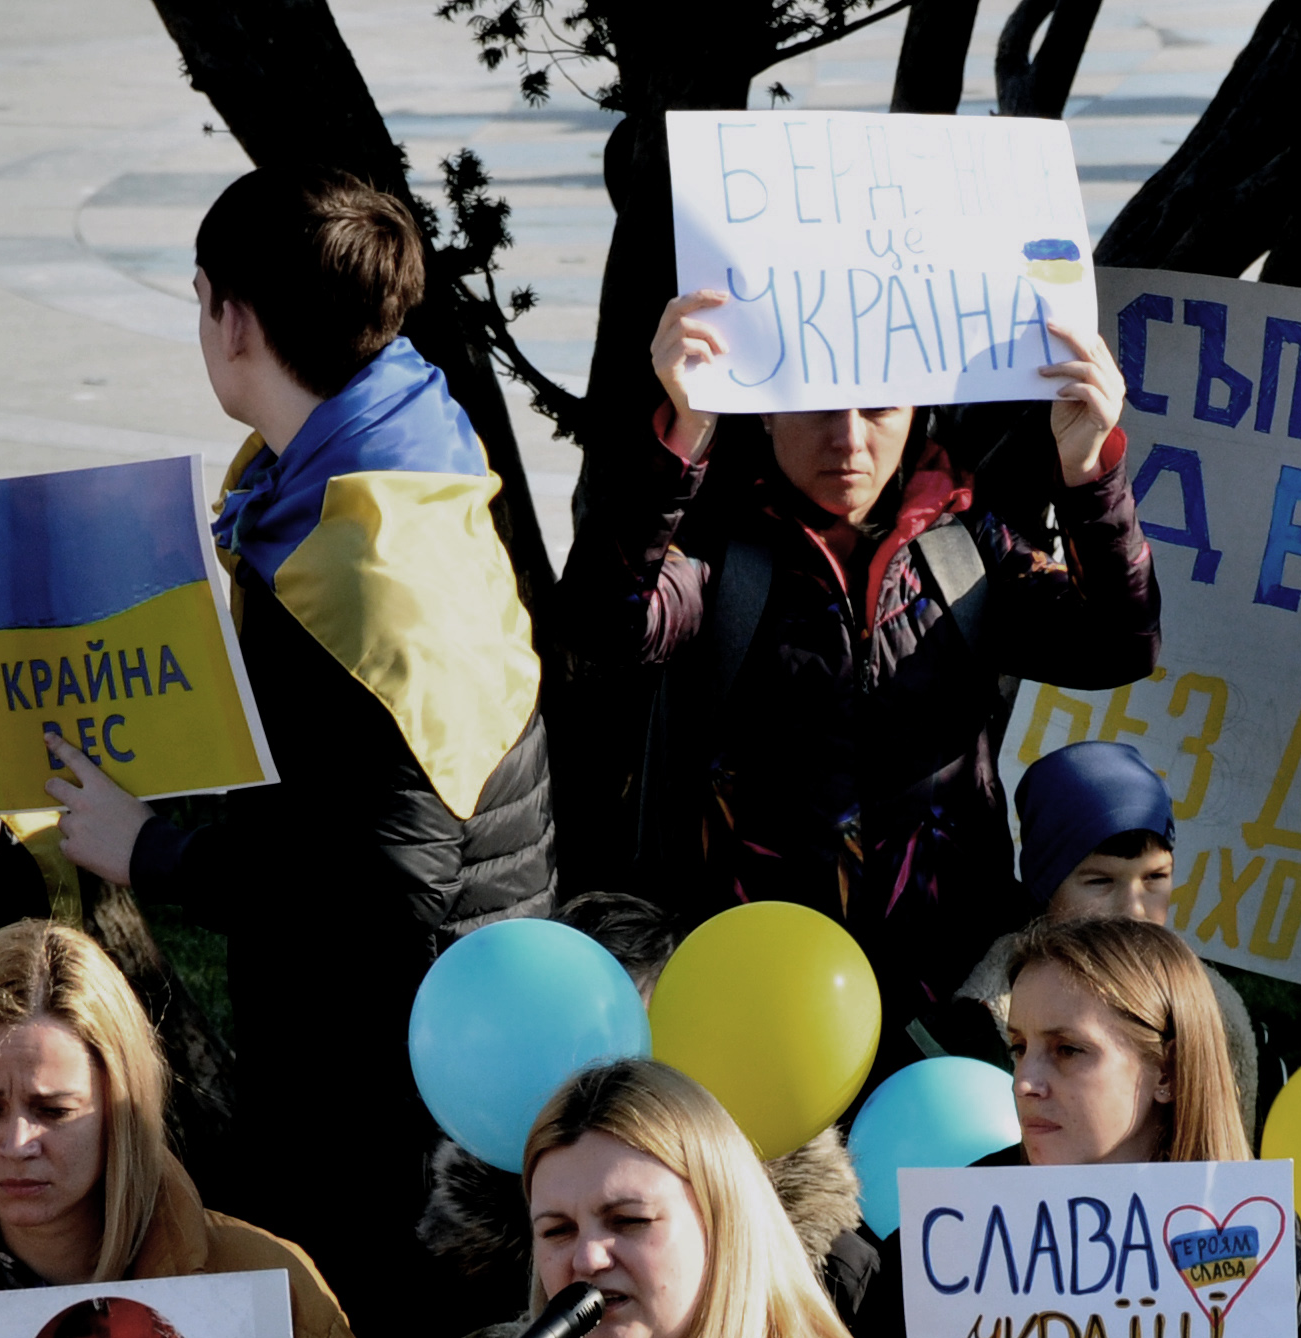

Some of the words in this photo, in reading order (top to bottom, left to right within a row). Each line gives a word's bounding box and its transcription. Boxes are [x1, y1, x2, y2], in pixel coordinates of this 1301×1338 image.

[726, 264, 1056, 388] УКРАЇНА
[922, 1192, 1159, 1295] СЛАВА
[1171, 1232, 1254, 1263] ГЕРОЯМ
[1189, 1260, 1247, 1282] СЛАВА
